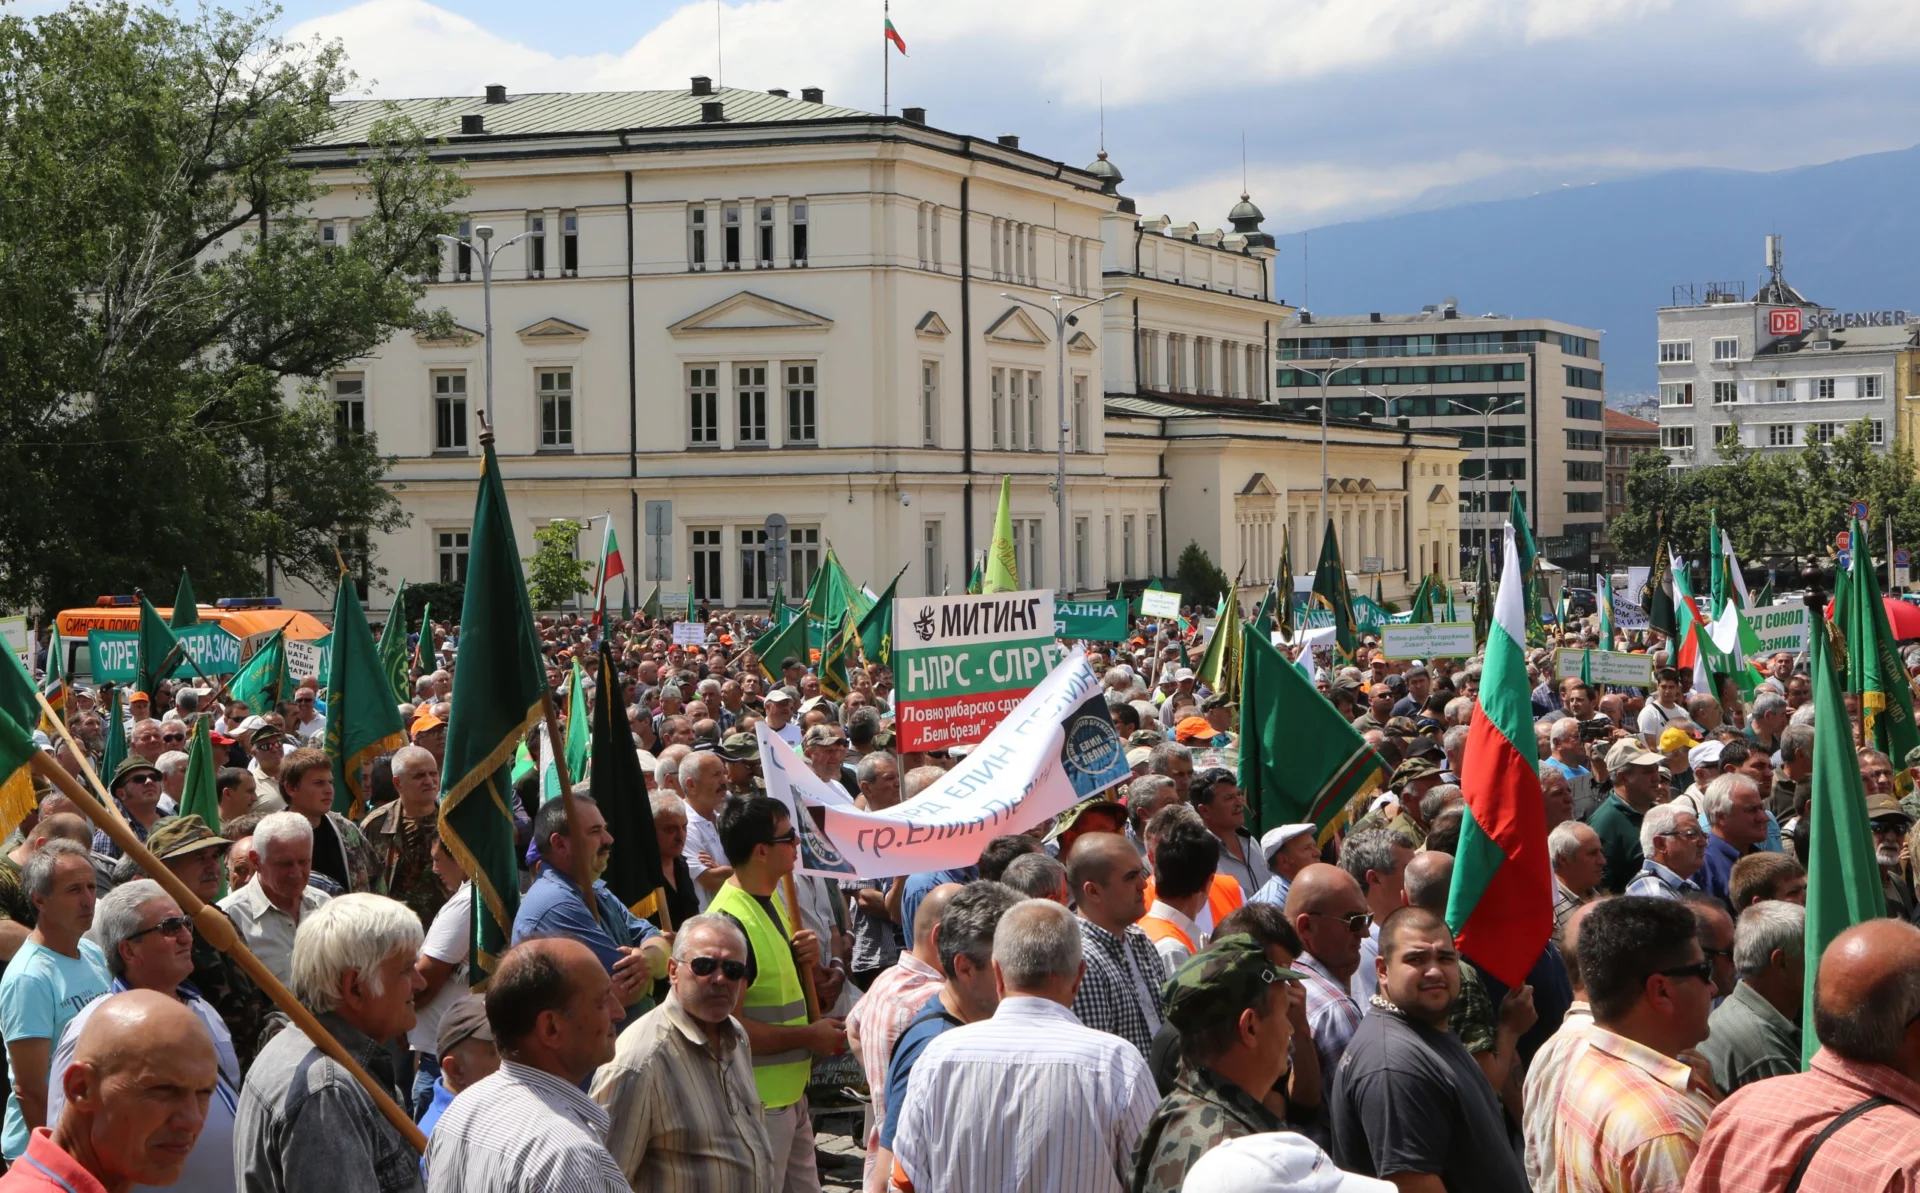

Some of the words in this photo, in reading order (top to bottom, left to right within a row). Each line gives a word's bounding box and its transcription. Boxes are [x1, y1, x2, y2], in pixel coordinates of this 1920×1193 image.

[1773, 314, 1797, 331] DB
[1808, 310, 1905, 329] SCHENKER
[1837, 537, 1850, 545] STO
[940, 598, 1041, 638] МИТИНГ
[1054, 604, 1118, 618] АЛНА
[1744, 614, 1763, 632] РД
[1765, 608, 1804, 629] СОКОЛ
[108, 618, 141, 632] ПОМО
[181, 633, 241, 665] ОБРАЗИЯ
[908, 652, 970, 692] НЛРС
[902, 706, 944, 723] Ловно
[945, 700, 996, 720] рибарско
[997, 697, 1025, 714] сдр
[913, 725, 949, 746] „Бели
[950, 719, 987, 743] брези“
[1078, 734, 1103, 752] ЕЛИН
[1081, 743, 1112, 765] ПЕЛИН
[944, 744, 1018, 799] ЕЛИН
